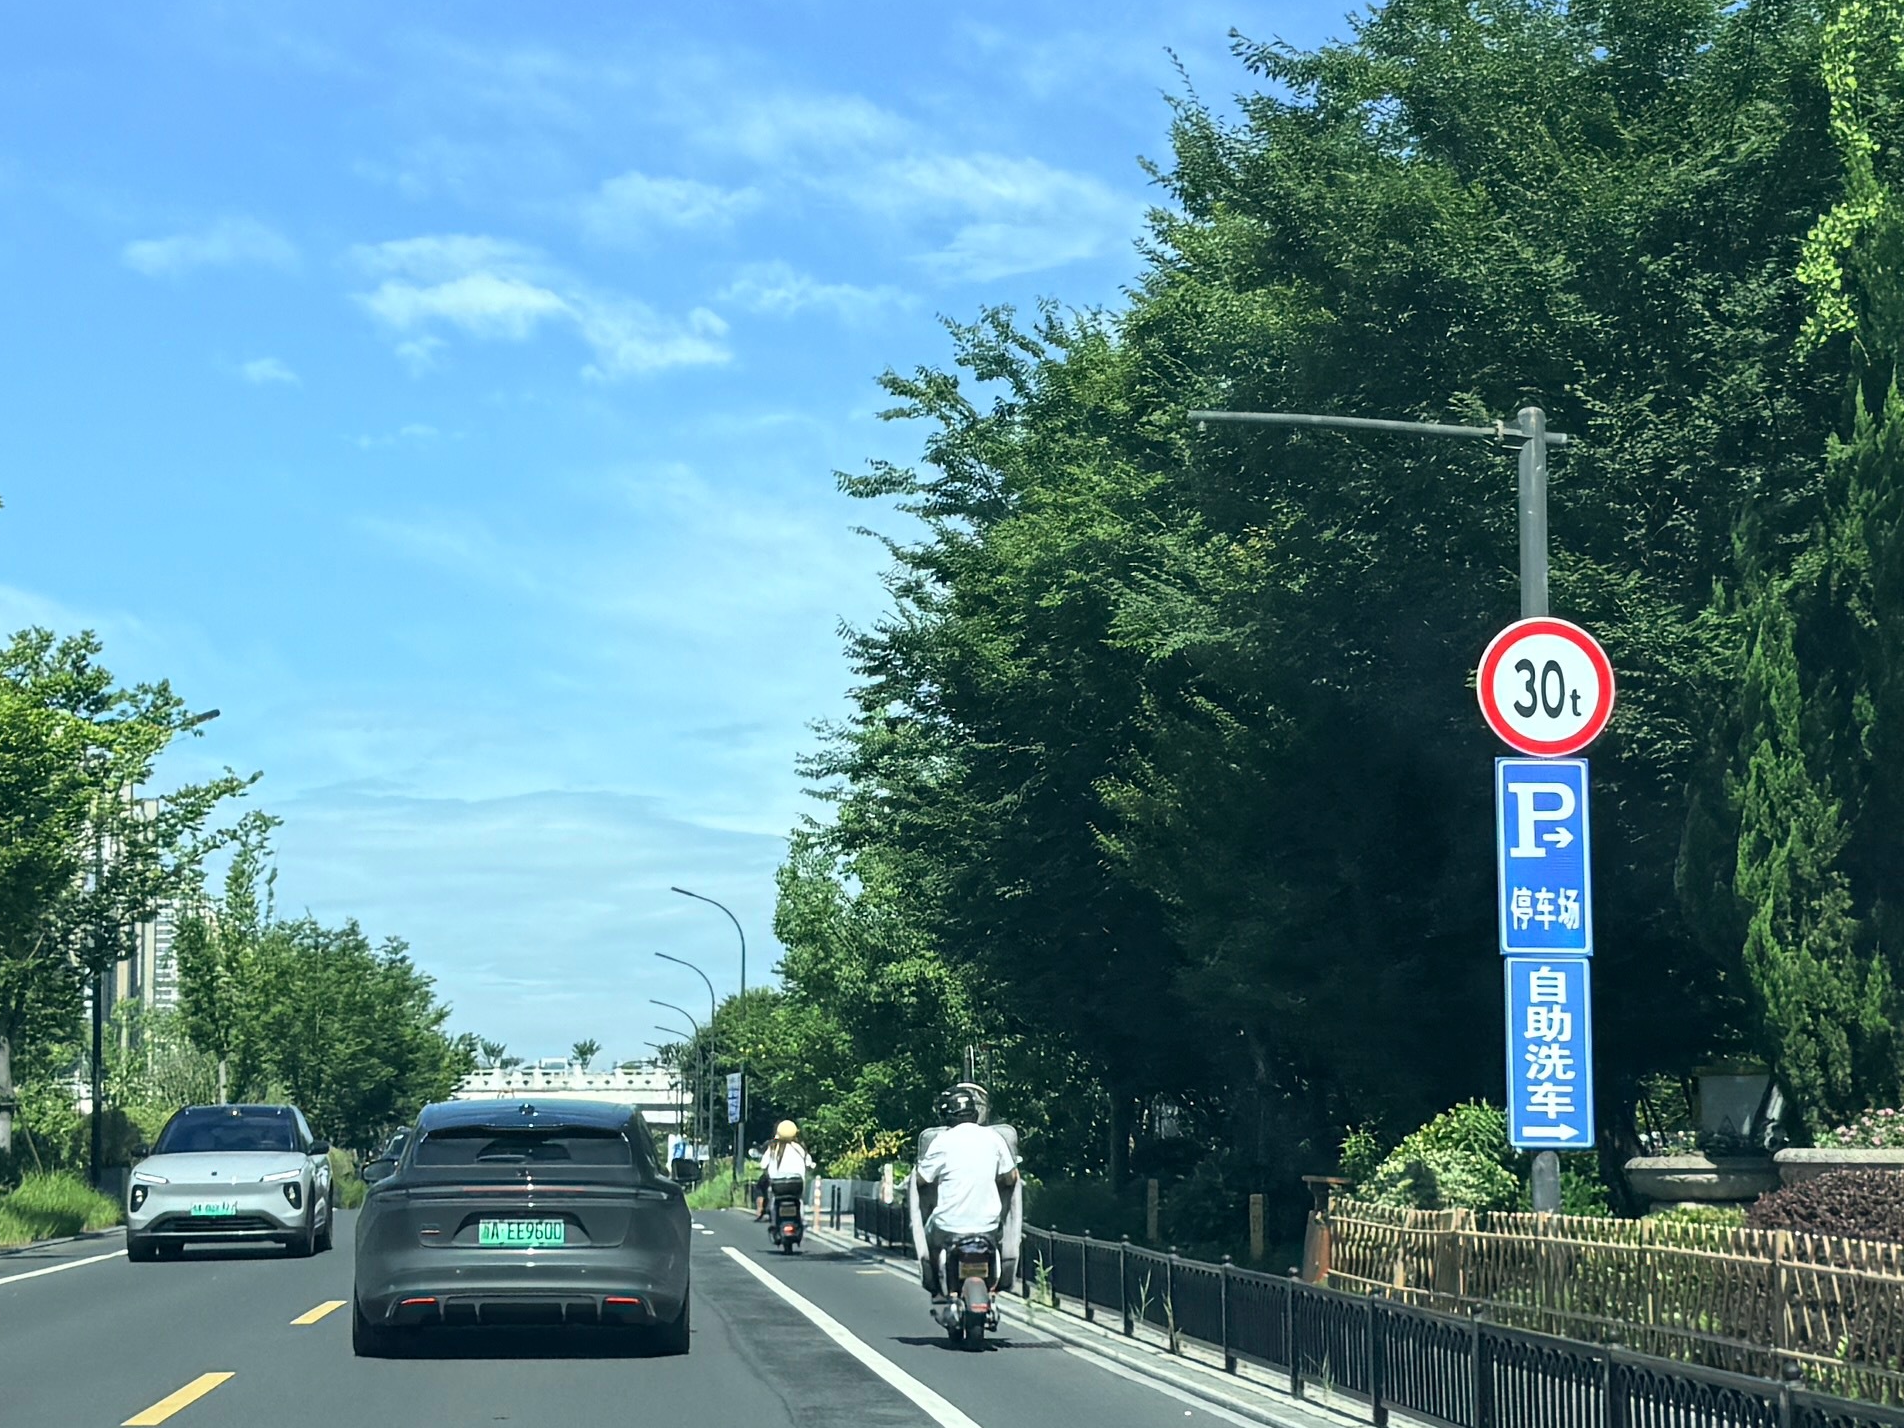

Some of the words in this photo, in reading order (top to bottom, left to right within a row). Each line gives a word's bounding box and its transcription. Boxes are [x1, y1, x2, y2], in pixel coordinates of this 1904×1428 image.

[1513, 658, 1582, 719] 30t
[1507, 782, 1576, 858] P
[1510, 886, 1581, 931] 停车场
[1524, 965, 1576, 1120] 自助洗车
